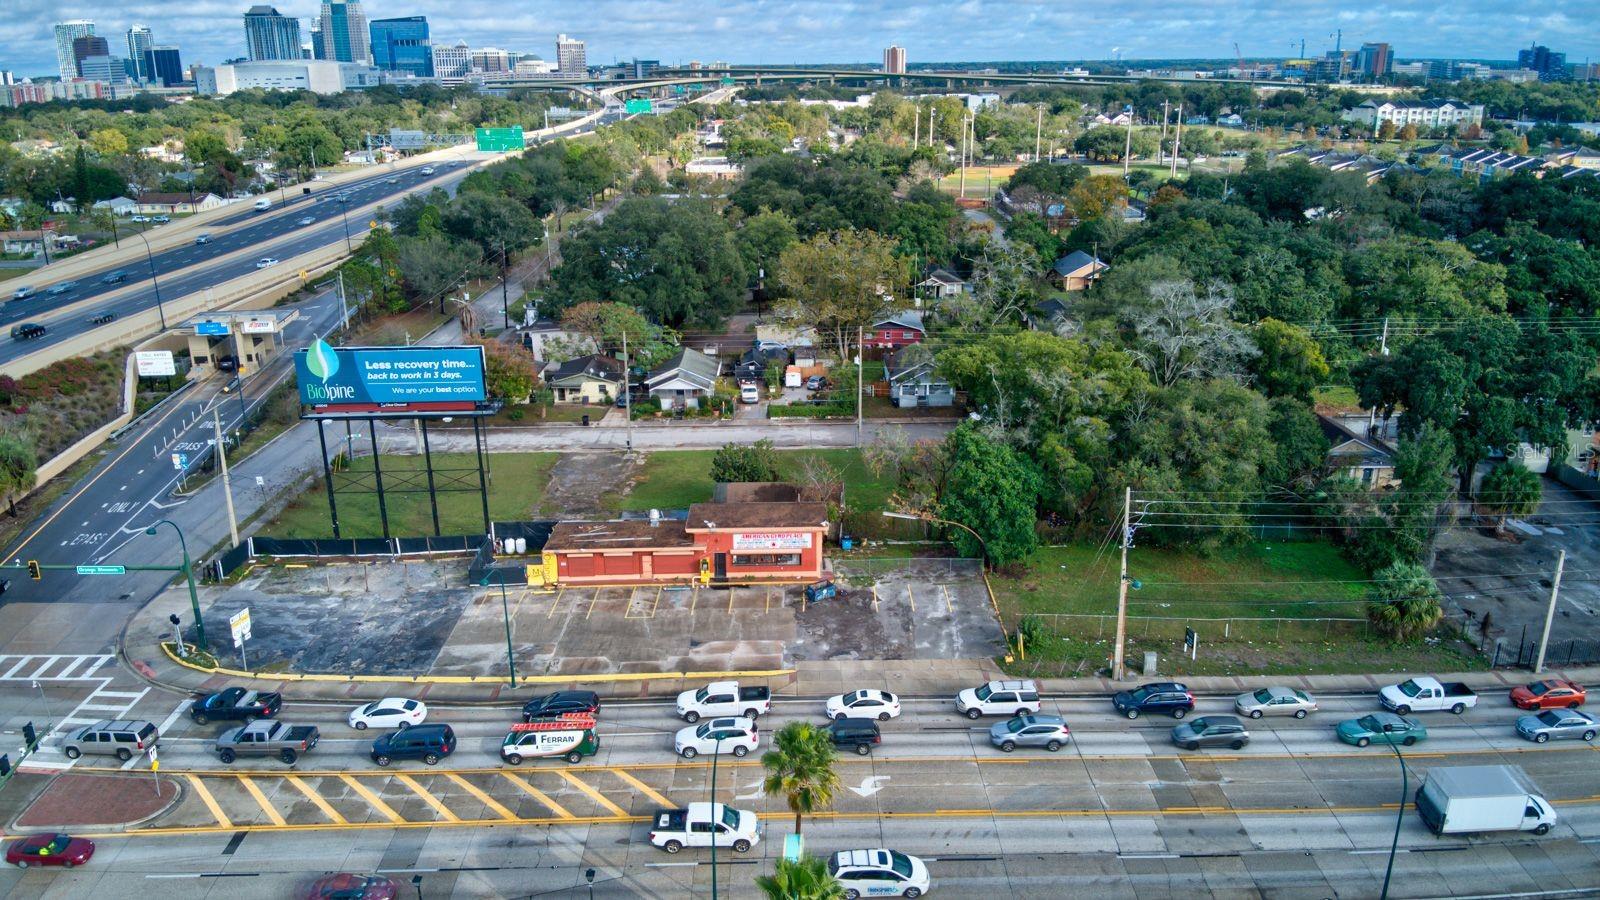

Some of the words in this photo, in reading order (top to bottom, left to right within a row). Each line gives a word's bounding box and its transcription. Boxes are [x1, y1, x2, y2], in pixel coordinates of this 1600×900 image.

[365, 360, 391, 370] Less
[394, 361, 439, 371] recovery
[442, 359, 475, 368] time...
[367, 372, 388, 380] back
[440, 371, 462, 380] days.
[307, 383, 355, 401] BioSpine
[107, 502, 141, 513] ONLY
[541, 735, 575, 743] FERRAN
